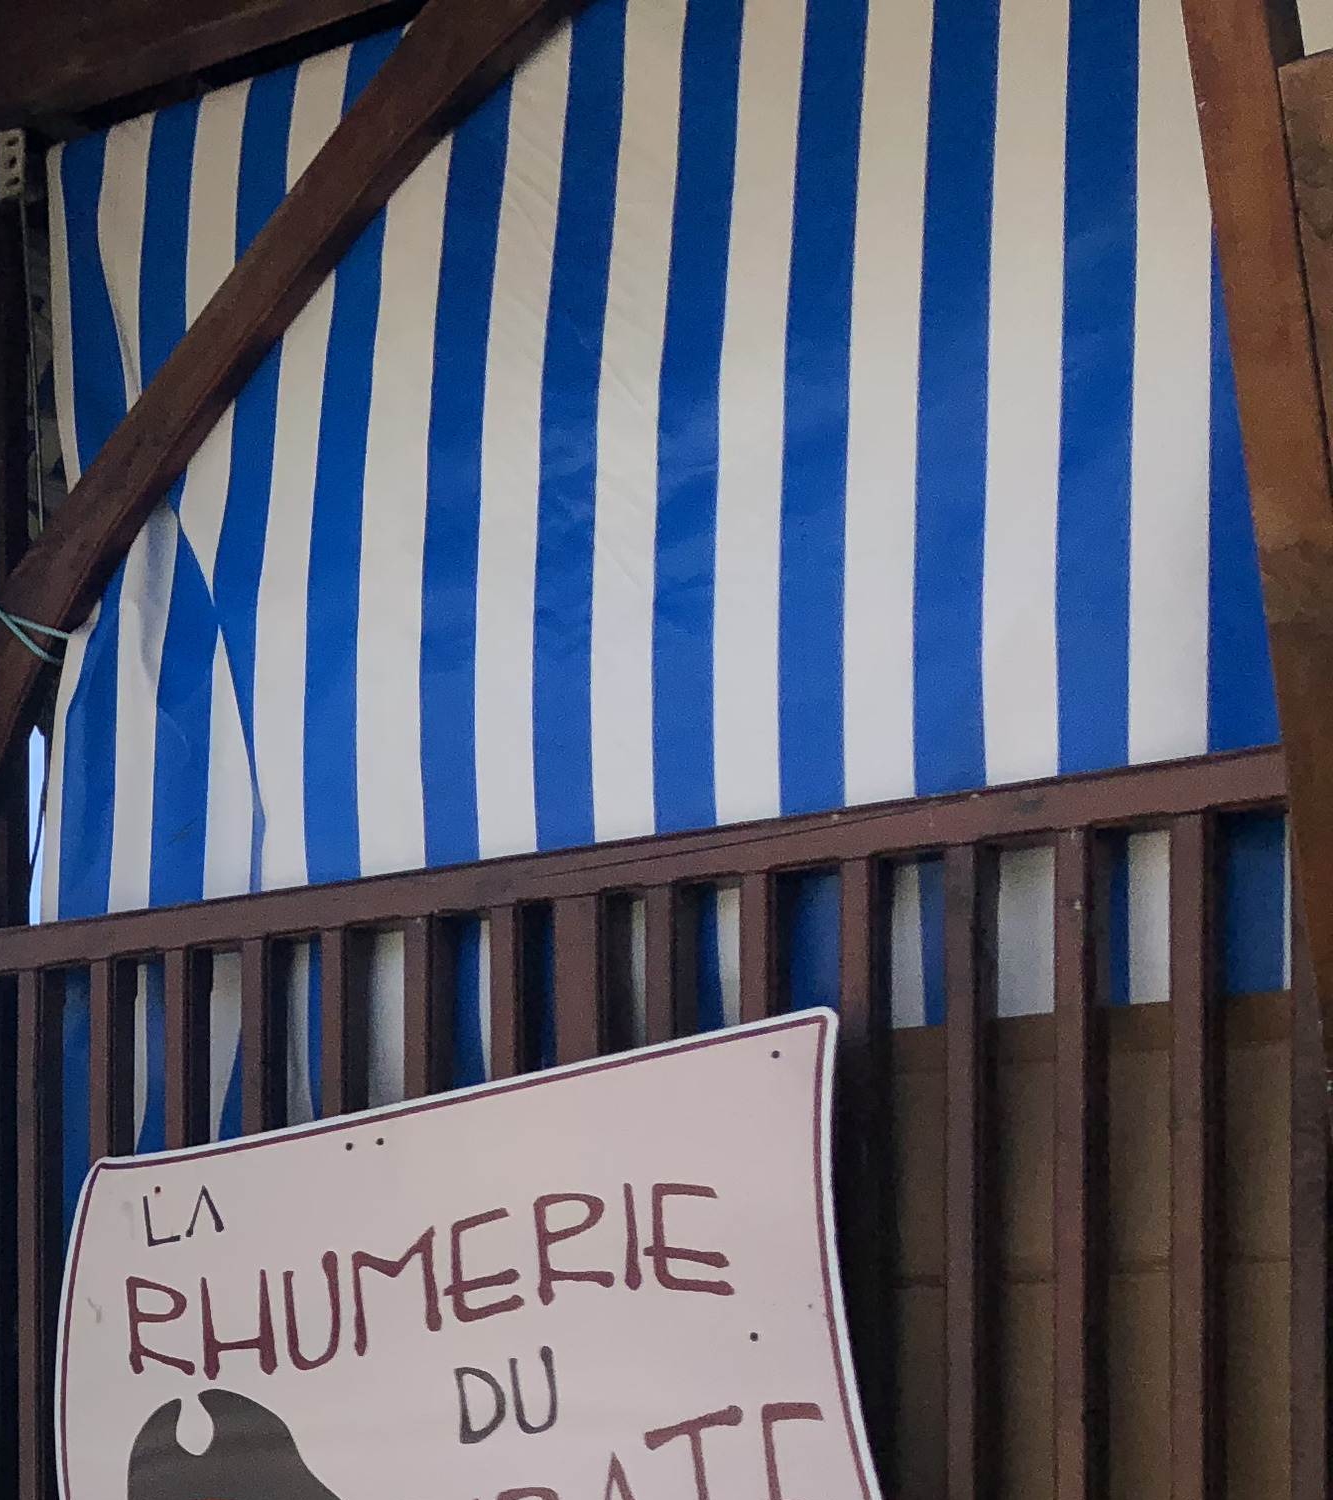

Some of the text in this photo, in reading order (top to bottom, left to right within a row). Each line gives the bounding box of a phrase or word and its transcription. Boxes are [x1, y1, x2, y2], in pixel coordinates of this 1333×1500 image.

[141, 1184, 226, 1249] LA
[125, 1181, 735, 1382] RHUMERIE
[453, 1345, 559, 1445] DU
